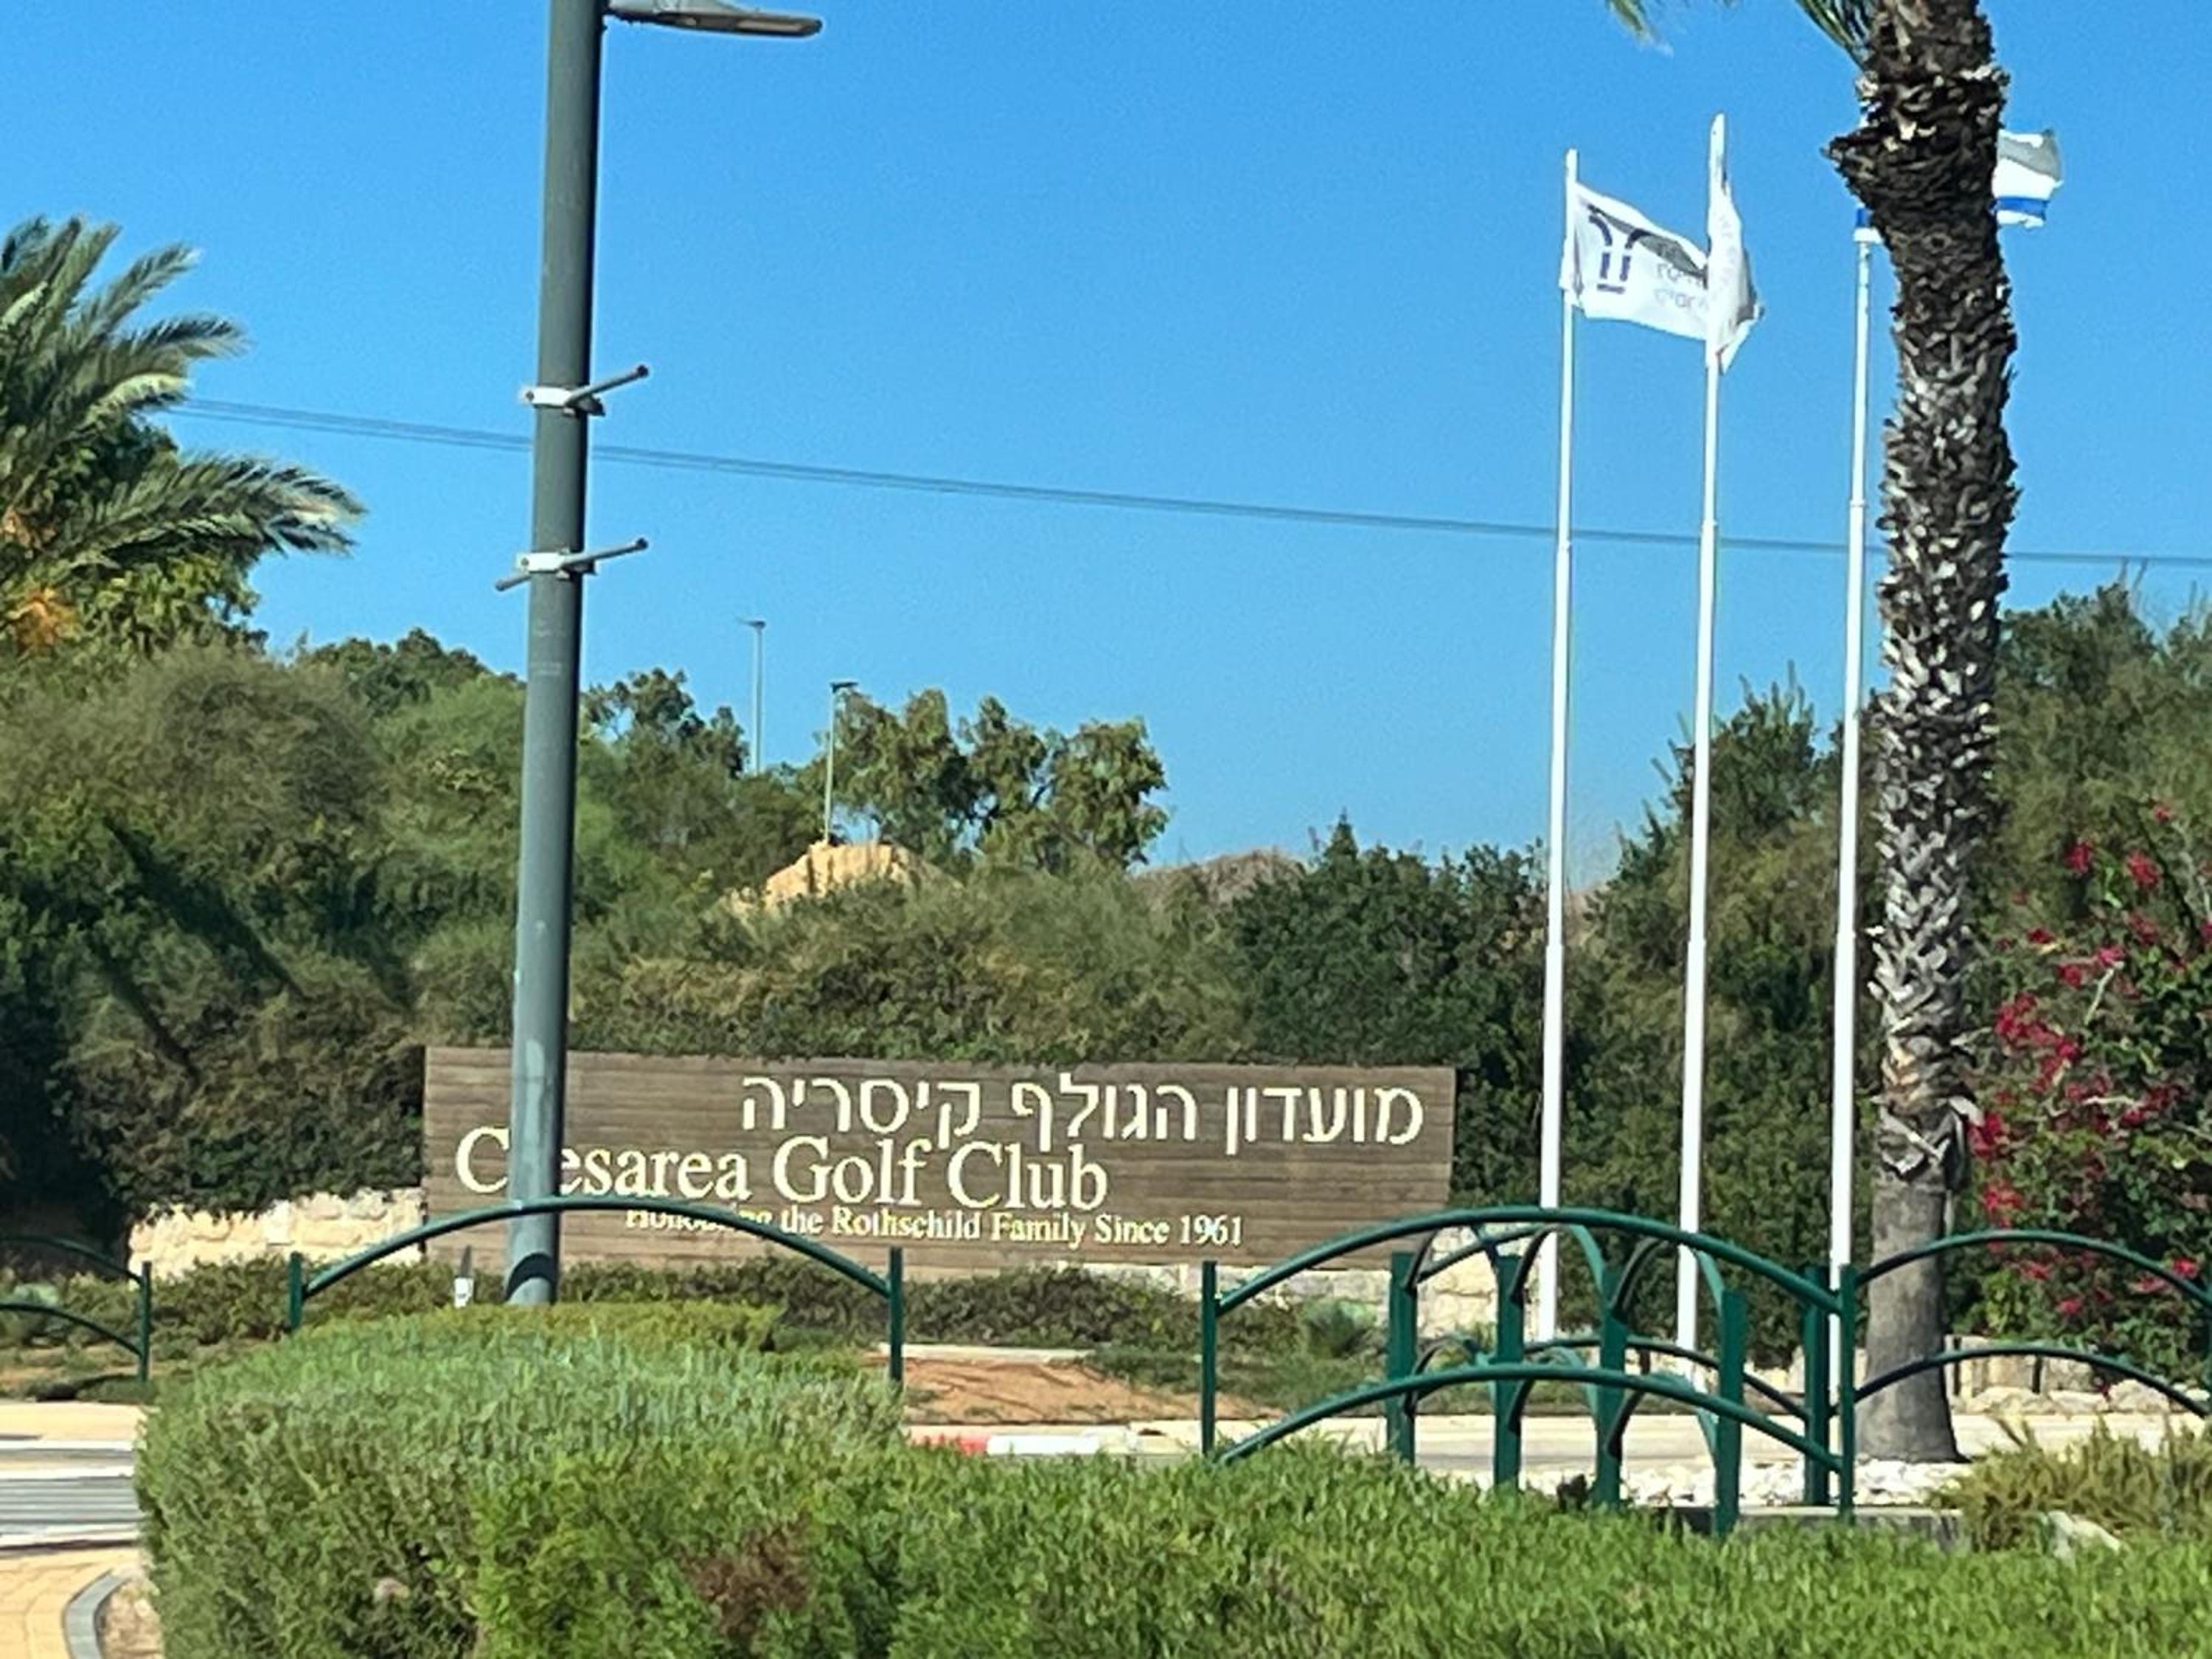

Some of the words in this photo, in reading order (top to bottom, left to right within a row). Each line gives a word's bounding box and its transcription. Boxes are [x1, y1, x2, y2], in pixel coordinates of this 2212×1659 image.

[742, 1077, 980, 1150] קיסריה
[1012, 1073, 1197, 1152] הגולף
[1227, 1088, 1423, 1155] מועדון
[456, 1127, 752, 1200] Cesarea
[773, 1136, 932, 1206] Golf
[948, 1141, 1107, 1210] Club
[781, 1205, 824, 1234] the
[831, 1205, 981, 1239] Rothschild
[990, 1212, 1086, 1250] Family
[1094, 1213, 1170, 1244] Since
[1180, 1215, 1241, 1245] 1961
